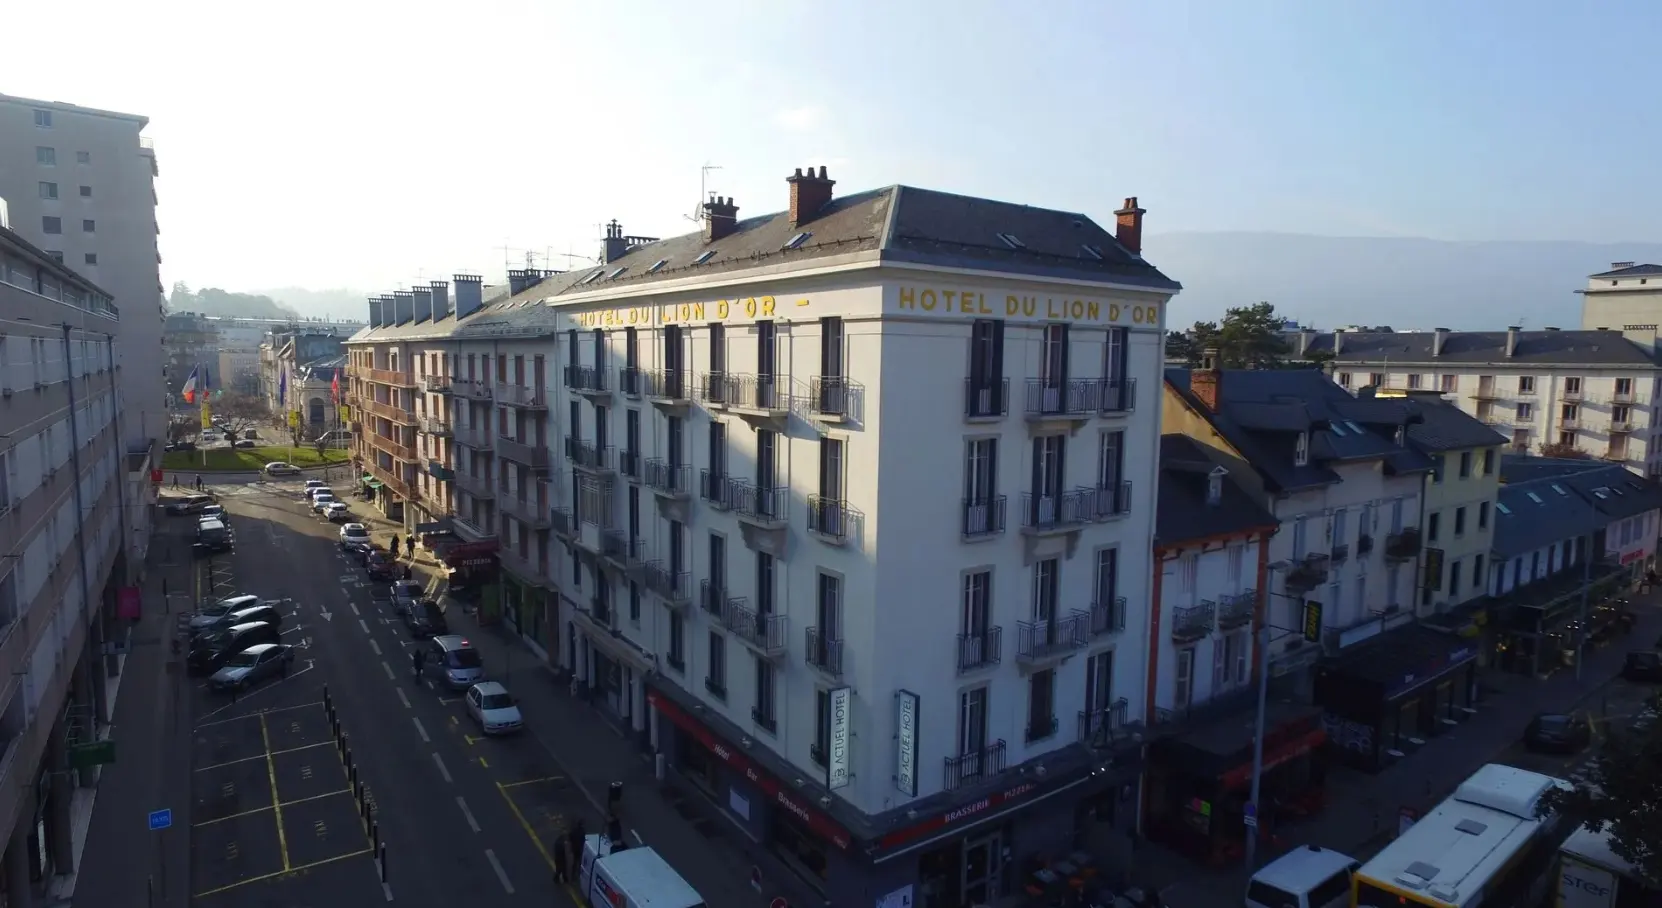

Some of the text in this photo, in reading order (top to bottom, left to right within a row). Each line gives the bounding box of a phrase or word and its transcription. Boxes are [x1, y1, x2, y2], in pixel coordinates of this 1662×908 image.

[580, 308, 623, 327] HOTEL
[628, 306, 650, 325] DU
[661, 302, 706, 322] LION
[899, 286, 993, 314] HOTEL
[1005, 295, 1036, 317] DU
[1047, 298, 1100, 321] LION
[834, 691, 846, 764] ACTUEL HOTEL
[901, 698, 912, 772] ACTUEL HOTEL
[746, 767, 758, 782] Bar
[778, 792, 810, 822] Brasserie
[945, 798, 990, 824] BRASSERIE
